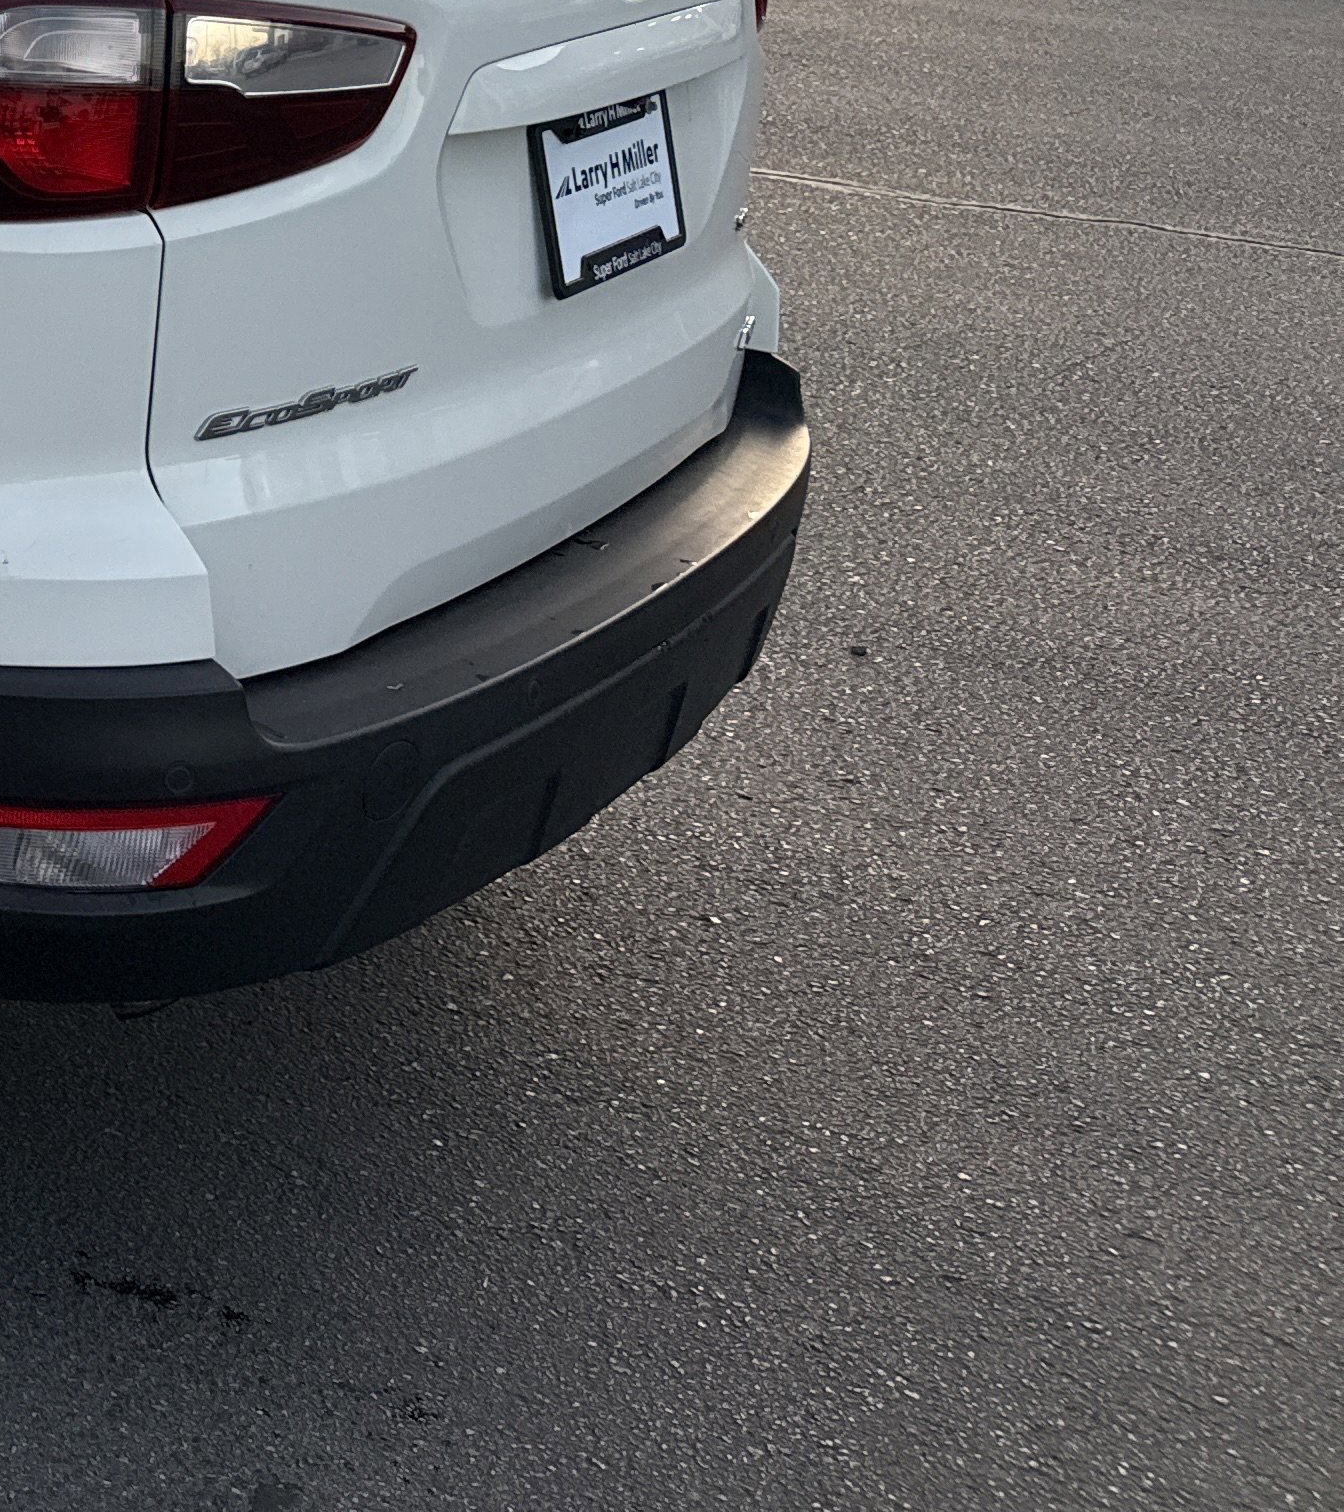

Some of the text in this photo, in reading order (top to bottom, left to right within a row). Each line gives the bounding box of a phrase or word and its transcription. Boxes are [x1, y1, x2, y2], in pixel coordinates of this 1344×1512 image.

[583, 109, 608, 129] Larry
[608, 105, 617, 121] H
[571, 138, 659, 193] Larry H Miller
[594, 191, 612, 206] Super
[612, 181, 627, 198] Ford
[593, 261, 612, 281] Super
[611, 251, 628, 272] Ford
